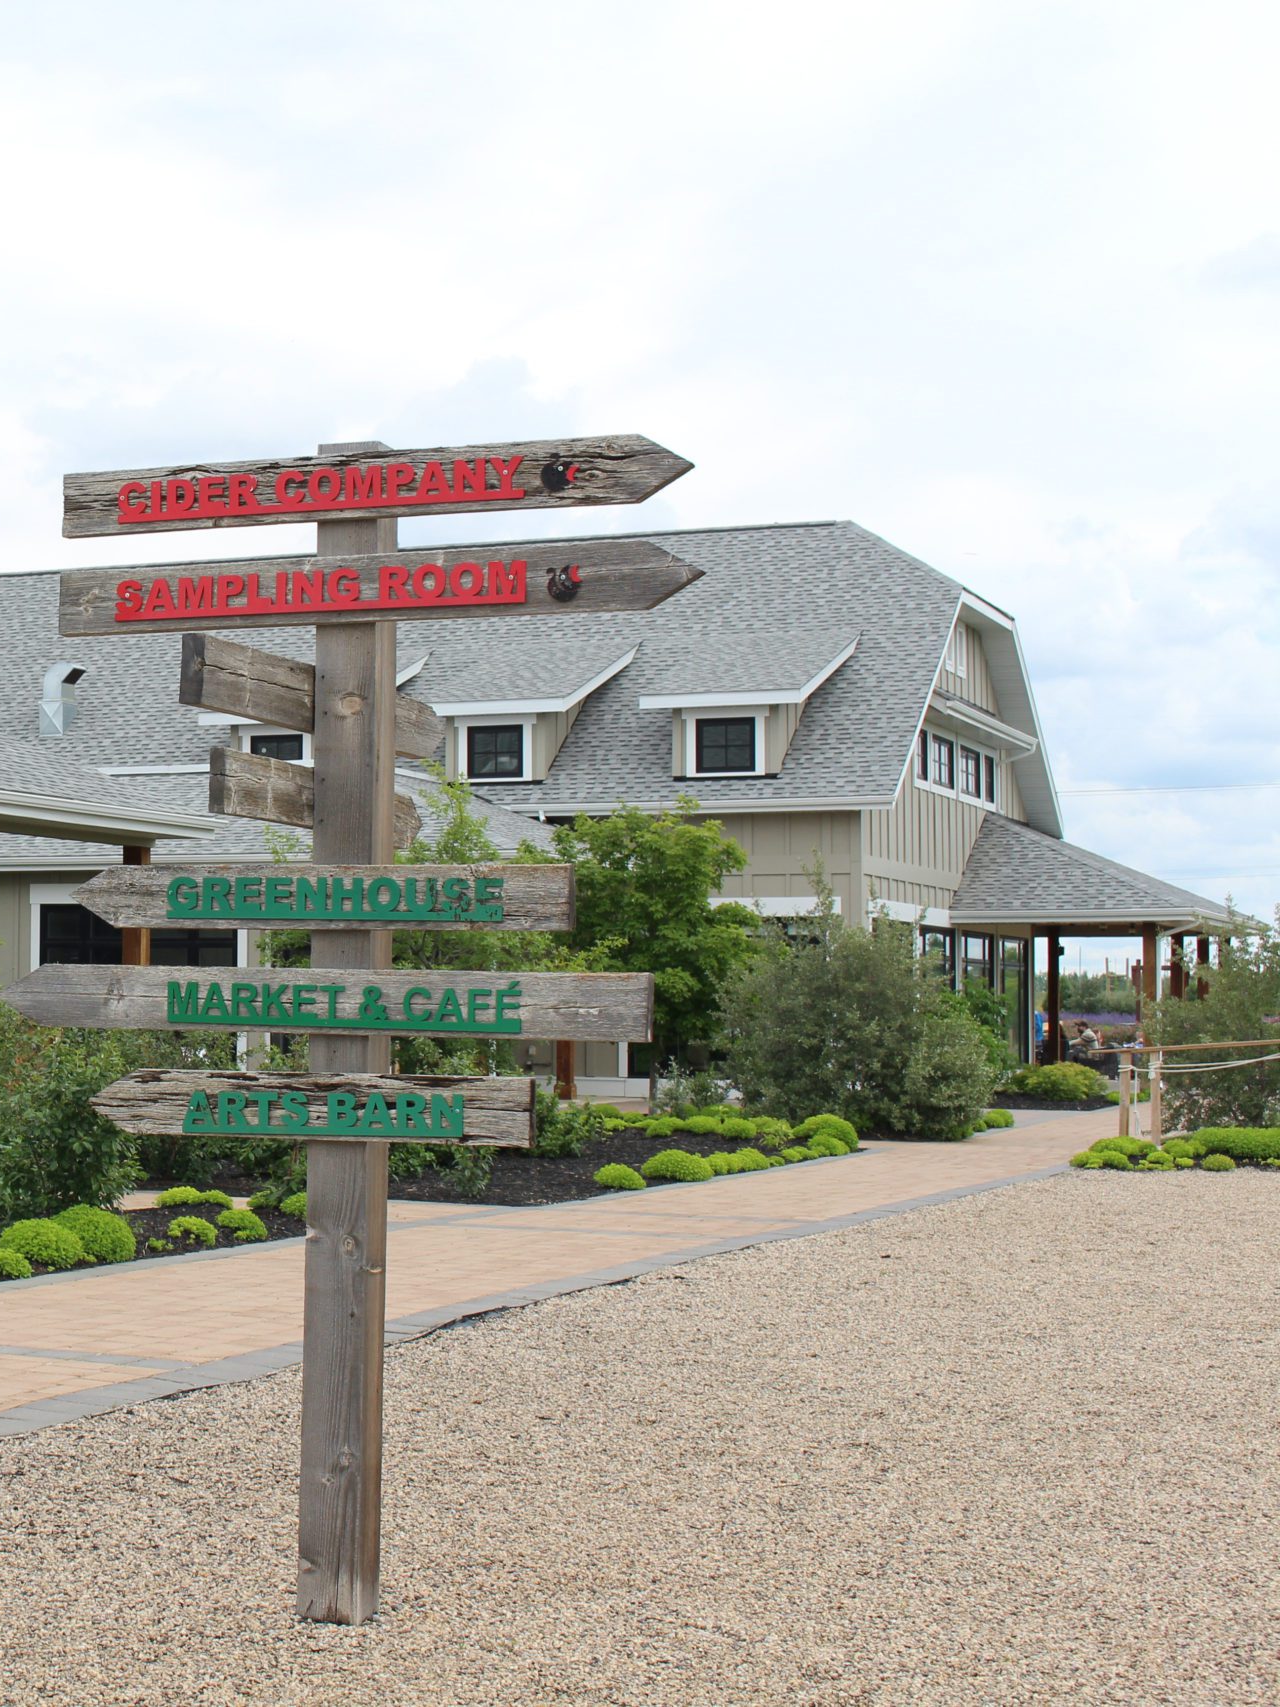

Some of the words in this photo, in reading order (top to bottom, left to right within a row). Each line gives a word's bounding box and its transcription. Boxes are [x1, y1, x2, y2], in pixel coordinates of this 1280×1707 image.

[119, 474, 257, 517] CIDER
[275, 455, 524, 505] COMPANY
[116, 567, 361, 615] SAMPLING
[379, 560, 526, 604] ROOM
[167, 876, 504, 915] GREENHOUSE
[167, 980, 345, 1020] MARKET
[358, 985, 389, 1023] &
[403, 980, 522, 1024] CAFÉ
[183, 1089, 310, 1129] ARTS
[327, 1093, 464, 1132] BARN
